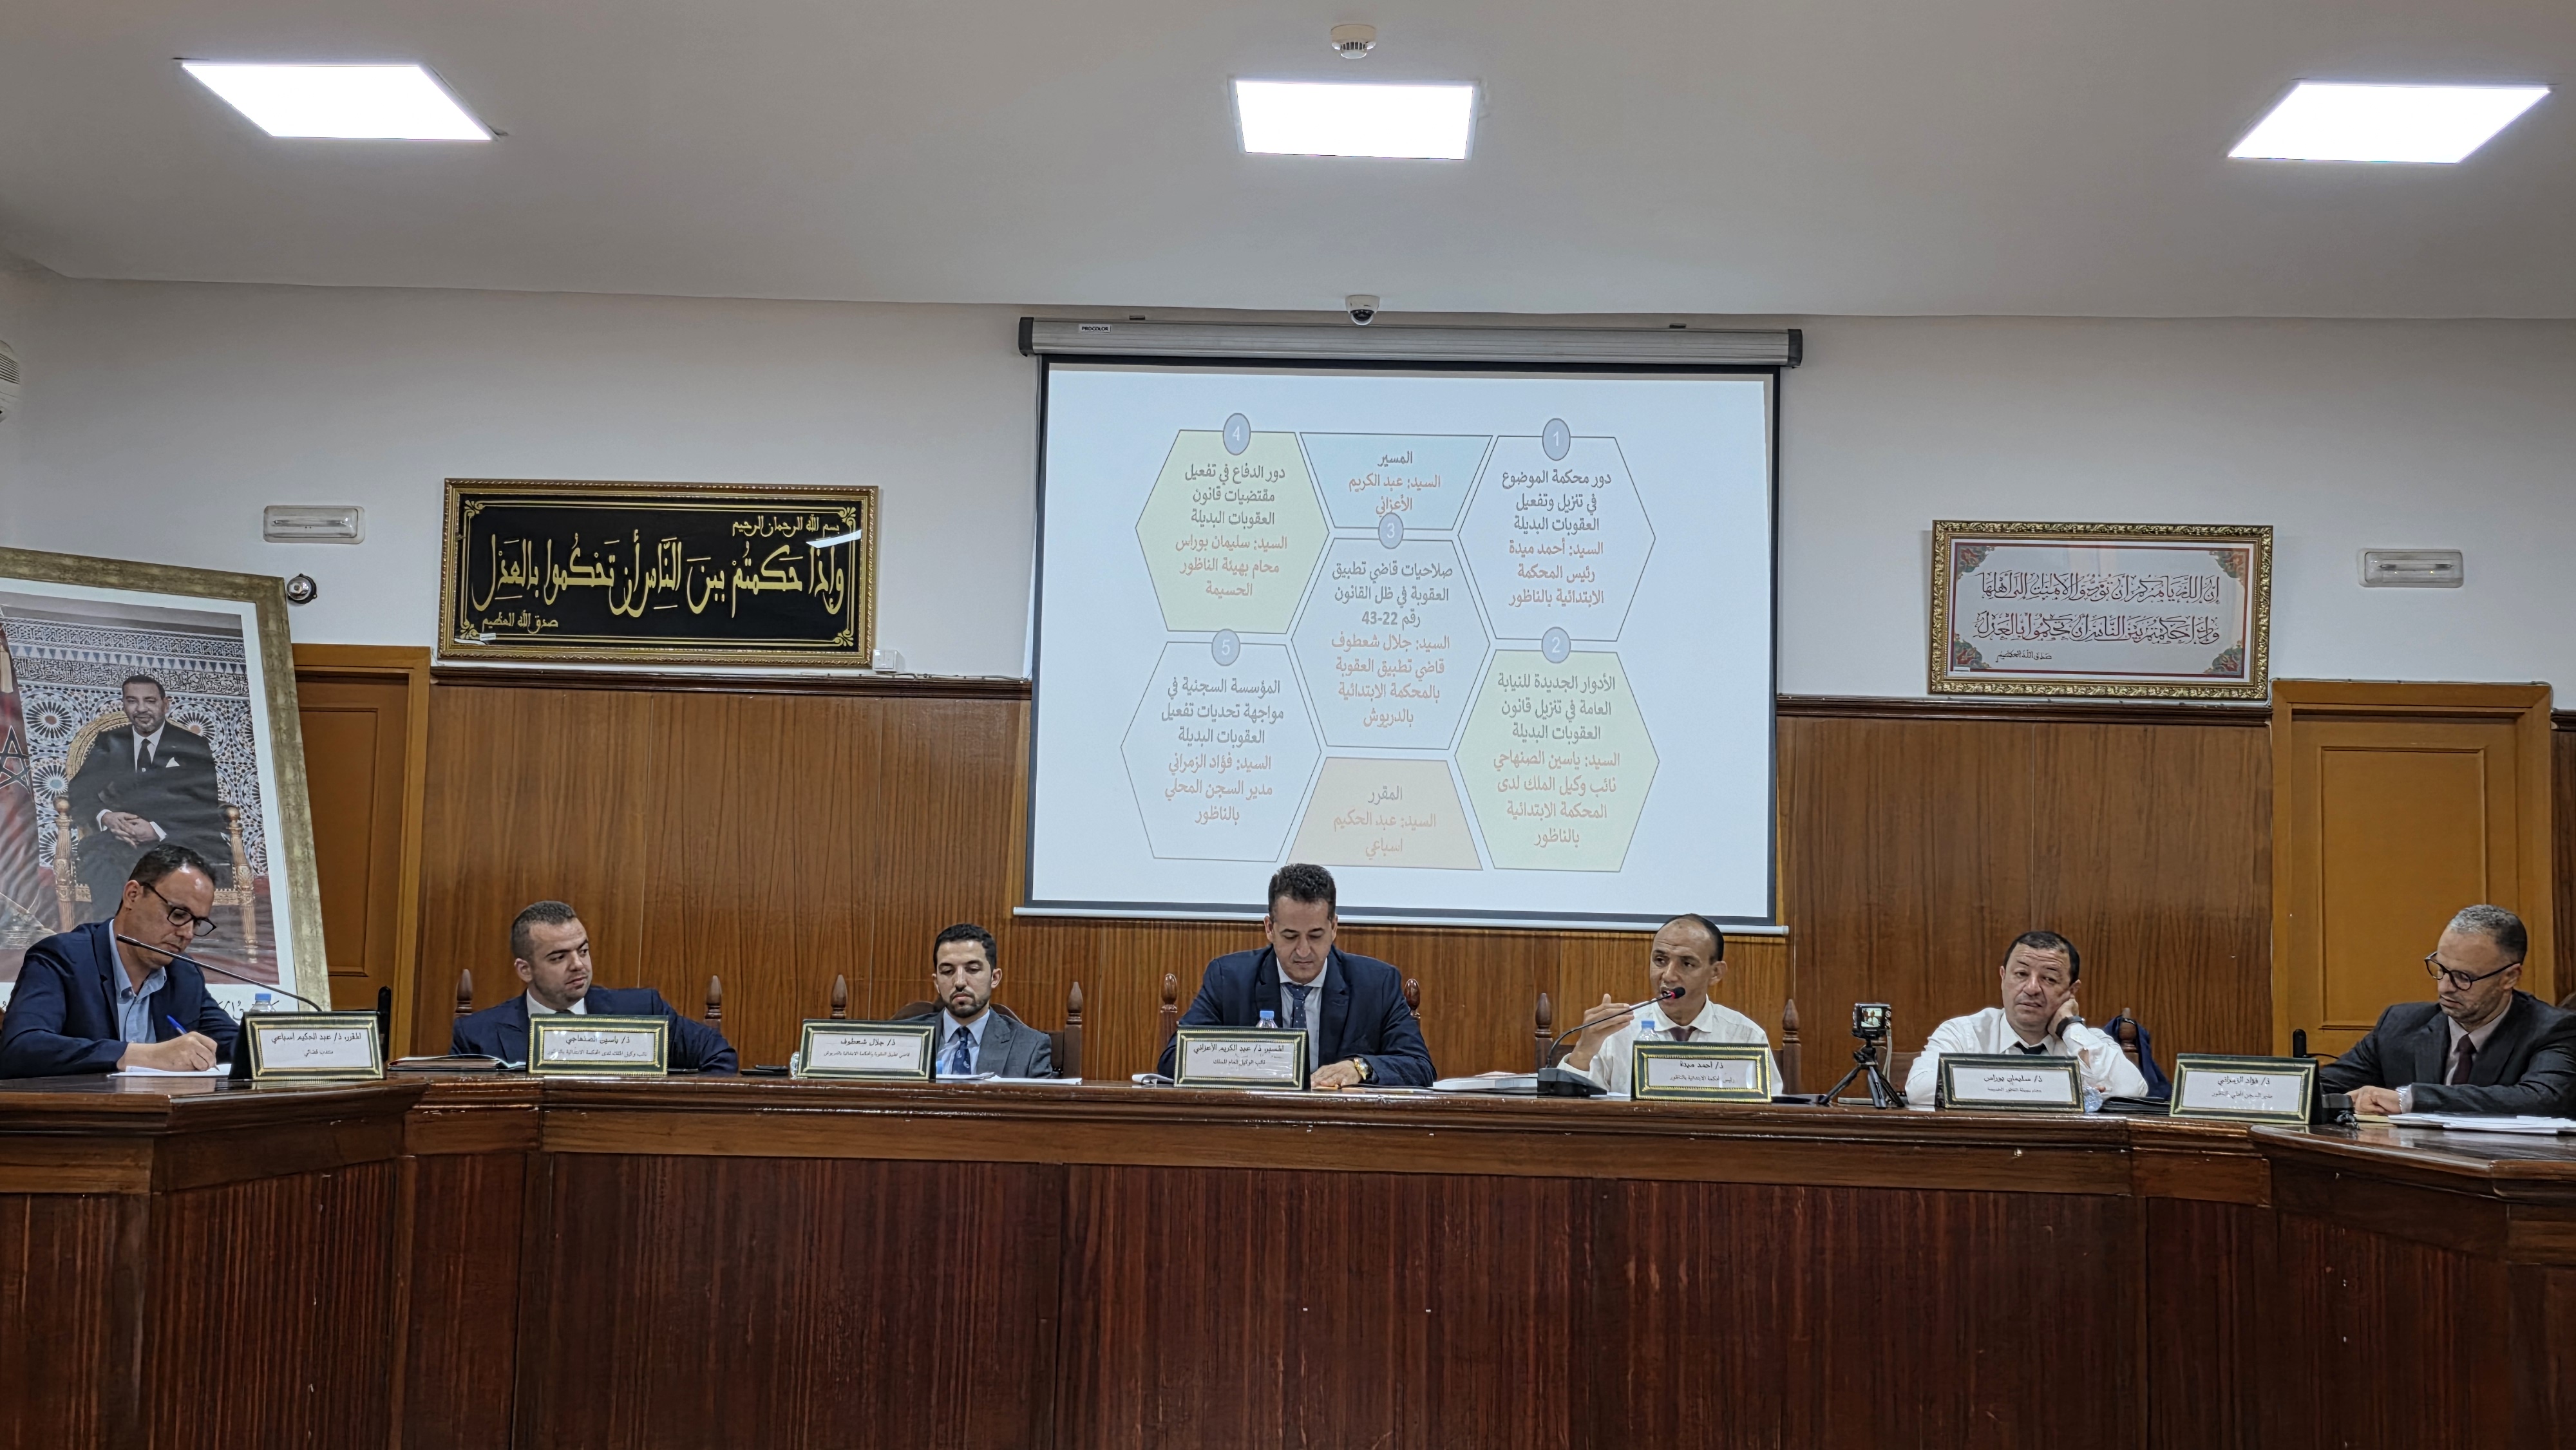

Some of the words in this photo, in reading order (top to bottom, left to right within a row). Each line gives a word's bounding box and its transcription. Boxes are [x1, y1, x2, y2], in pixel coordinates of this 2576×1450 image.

[1231, 426, 1240, 441] 4
[1552, 431, 1560, 447] 1
[1377, 451, 1412, 467] المسير
[1185, 462, 1217, 481] تفعيل
[1218, 464, 1229, 486] في
[1233, 462, 1264, 484] الدفاع
[1265, 469, 1285, 483] دور
[1502, 469, 1548, 489] الموضوع
[1552, 468, 1590, 484] محكمة
[1349, 472, 1380, 493] الكريم
[1383, 476, 1403, 491] عبد
[1407, 474, 1441, 491] السيد:
[1591, 474, 1611, 489] دور
[1193, 485, 1221, 505] قانون
[1224, 488, 1274, 505] مقتضيات
[1516, 493, 1554, 512] وتفعيل
[1557, 493, 1583, 513] تنزيل
[1587, 493, 1596, 516] في
[732, 515, 764, 537] الرحيم
[806, 514, 819, 532] الله
[1191, 508, 1225, 528] البديلة
[1228, 511, 1274, 530] العقوبات
[1514, 514, 1548, 534] البديلة
[1552, 517, 1599, 536] العقوبات
[822, 523, 840, 538] بسم
[1387, 522, 1395, 538] 3
[1175, 534, 1208, 552] بوراس
[1211, 534, 1250, 551] سليمان
[1254, 535, 1287, 552] السيد:
[1510, 540, 1534, 558] ميدة
[1537, 537, 1565, 555] أحمد
[1569, 541, 1603, 558] السيد:
[1179, 557, 1218, 576] الناظور
[1222, 557, 1249, 576] بهيئة
[1253, 560, 1279, 579] محام
[1332, 561, 1366, 580] تطبيق
[1370, 560, 1397, 584] قاضي
[1401, 562, 1453, 580] صلاحيات
[1517, 563, 1563, 579] المحكمة
[1566, 565, 1595, 583] رئيس
[1206, 580, 1253, 599] الحسيمة
[1334, 585, 1371, 604] القانون
[1375, 585, 1393, 604] ظل
[1397, 585, 1407, 608] في
[1411, 585, 1449, 606] العقوبة
[1508, 588, 1552, 607] بالناظور
[1556, 588, 1604, 608] الابتدائية
[482, 612, 515, 633] العظيم
[517, 610, 531, 628] الله
[527, 615, 558, 634] صدق
[1401, 607, 1421, 631] رقم
[1222, 639, 1230, 655] 5
[1332, 631, 1379, 652] شعطوف
[1383, 634, 1412, 652] جلال
[1416, 635, 1450, 652] السيد:
[1551, 637, 1561, 654] 2
[1336, 656, 1374, 677] العقوبة
[1377, 659, 1412, 677] تطبيق
[1416, 658, 1444, 682] قاضي
[1168, 677, 1178, 700] في
[1182, 677, 1227, 697] السجنية
[1231, 678, 1280, 699] المؤسسة
[1498, 672, 1530, 692] للنيابة
[1535, 673, 1578, 693] الجديدة
[1580, 673, 1615, 694] الأدوار
[1338, 682, 1386, 702] الابتدائية
[1390, 681, 1439, 704] بالمحكمة
[1162, 702, 1194, 721] تفعيل
[1197, 704, 1240, 722] تحديات
[1244, 702, 1283, 725] مواجهة
[1502, 697, 1531, 718] قانون
[1535, 699, 1562, 720] تنزيل
[1566, 699, 1576, 724] في
[1580, 699, 1611, 715] العامة
[1363, 708, 1414, 728] بالدريوش
[1179, 726, 1213, 747] البديلة
[1217, 729, 1265, 749] العقوبات
[1512, 722, 1548, 744] البديلة
[1552, 725, 1600, 745] العقوبات
[1169, 753, 1206, 776] الزمراني
[1209, 751, 1232, 774] فؤاد
[1236, 755, 1271, 773] السيد:
[1548, 751, 1580, 770] ياسين
[1585, 752, 1620, 770] السيد:
[1165, 778, 1202, 801] المحلي
[1206, 780, 1244, 798] السجن
[1245, 784, 1272, 800] مدير
[1497, 775, 1519, 792] لدى
[1524, 775, 1555, 791] الملك
[1560, 775, 1586, 796] وكيل
[1590, 777, 1616, 798] نائب
[1368, 786, 1402, 805] المقرر
[1195, 805, 1240, 825] بالناظور
[1506, 800, 1556, 821] الابتدائية
[1560, 801, 1607, 818] المحكمة
[1334, 809, 1372, 832] الحكيم
[1376, 815, 1396, 831] عبد
[1401, 813, 1435, 831] السيد:
[1533, 827, 1580, 848] بالناظور
[1366, 838, 1403, 860] اسباعي
[296, 1032, 317, 1041] الحكيم
[869, 1038, 884, 1047] جلال
[1218, 1044, 1237, 1053] الكريم
